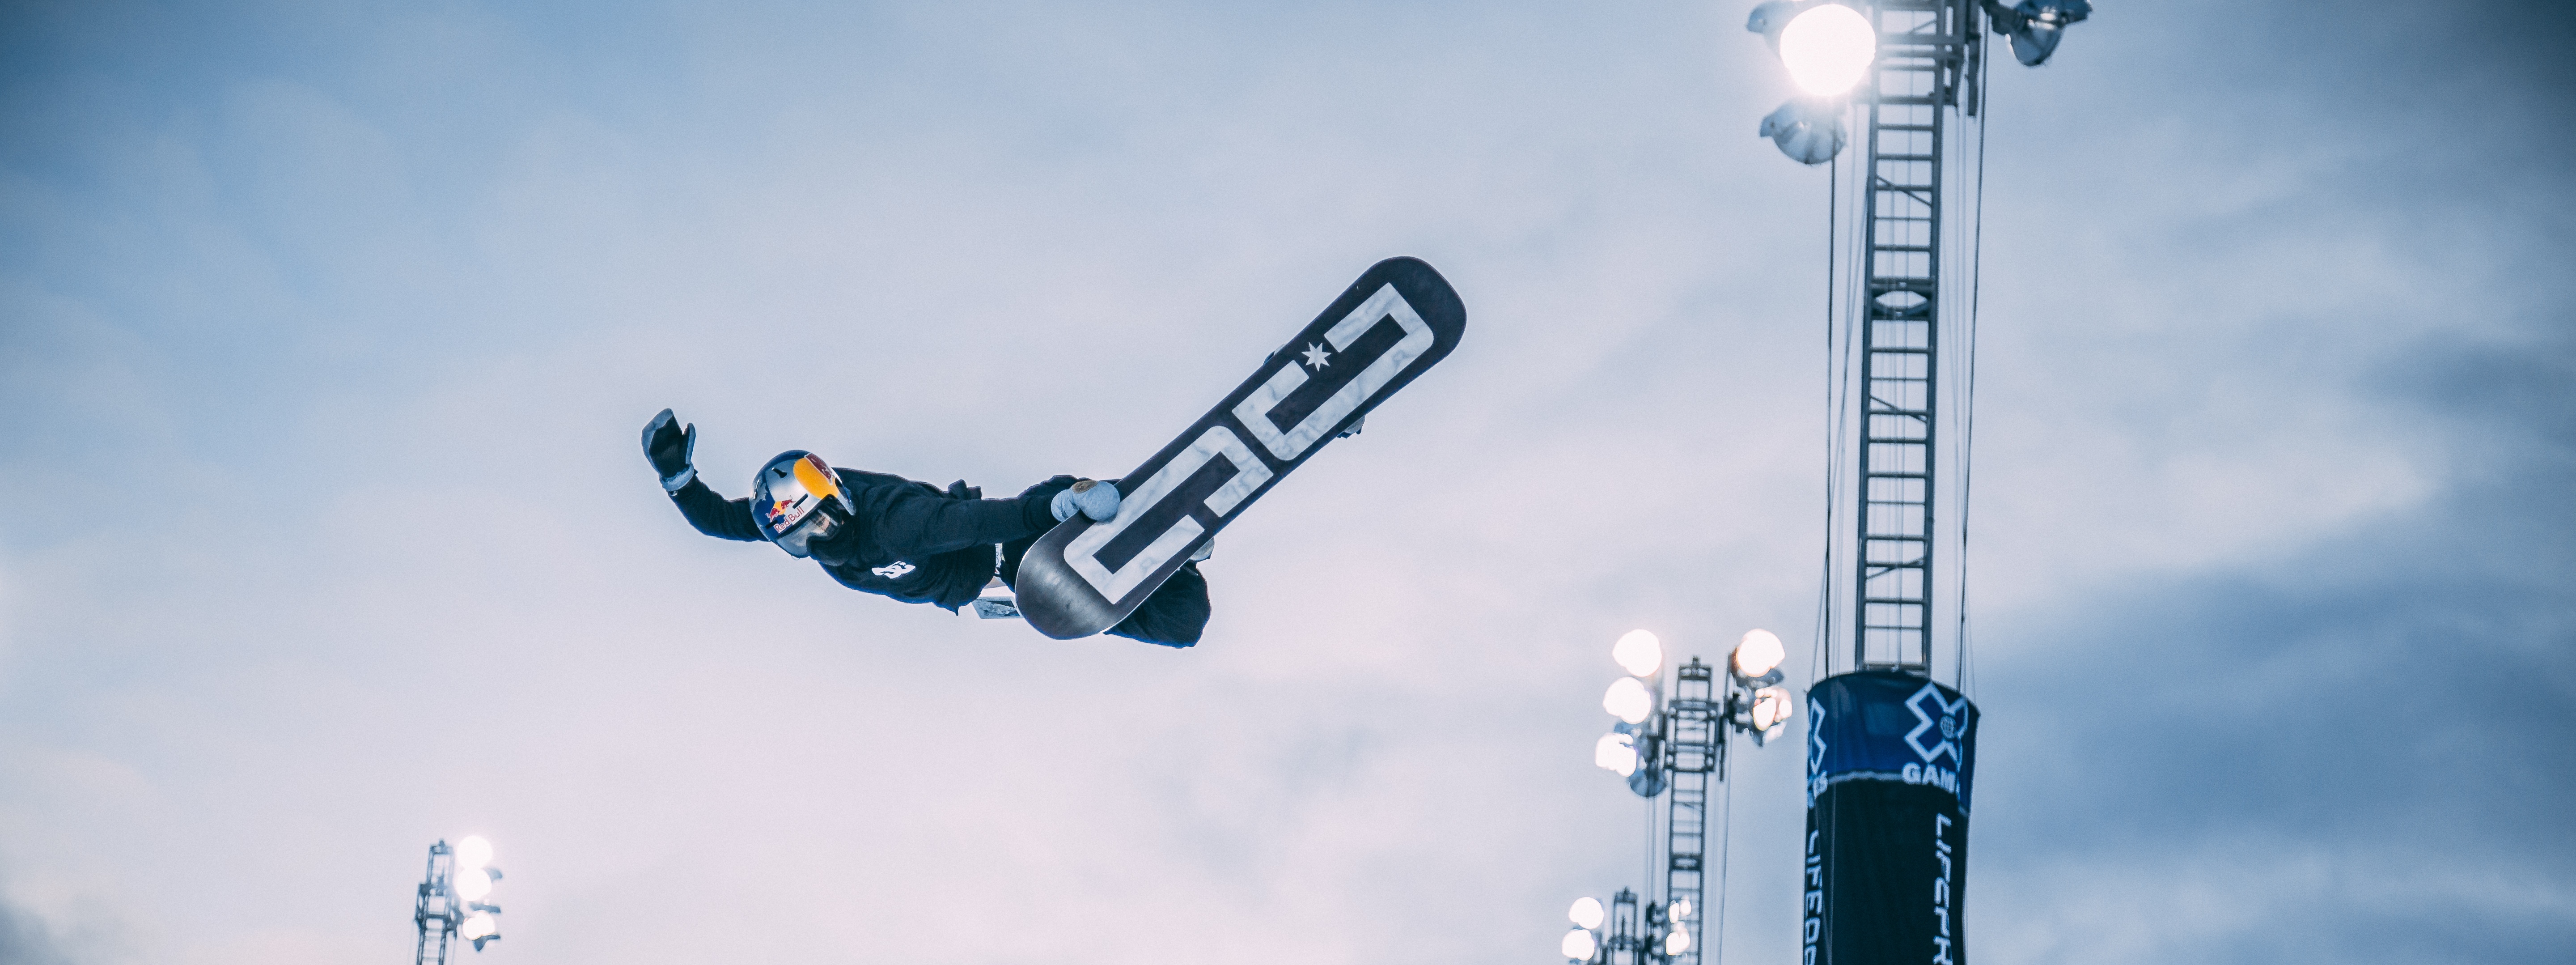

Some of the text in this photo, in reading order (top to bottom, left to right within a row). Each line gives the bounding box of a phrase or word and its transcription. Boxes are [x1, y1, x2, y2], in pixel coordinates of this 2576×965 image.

[774, 506, 805, 533] Red Bull
[1902, 761, 1960, 799] GAM
